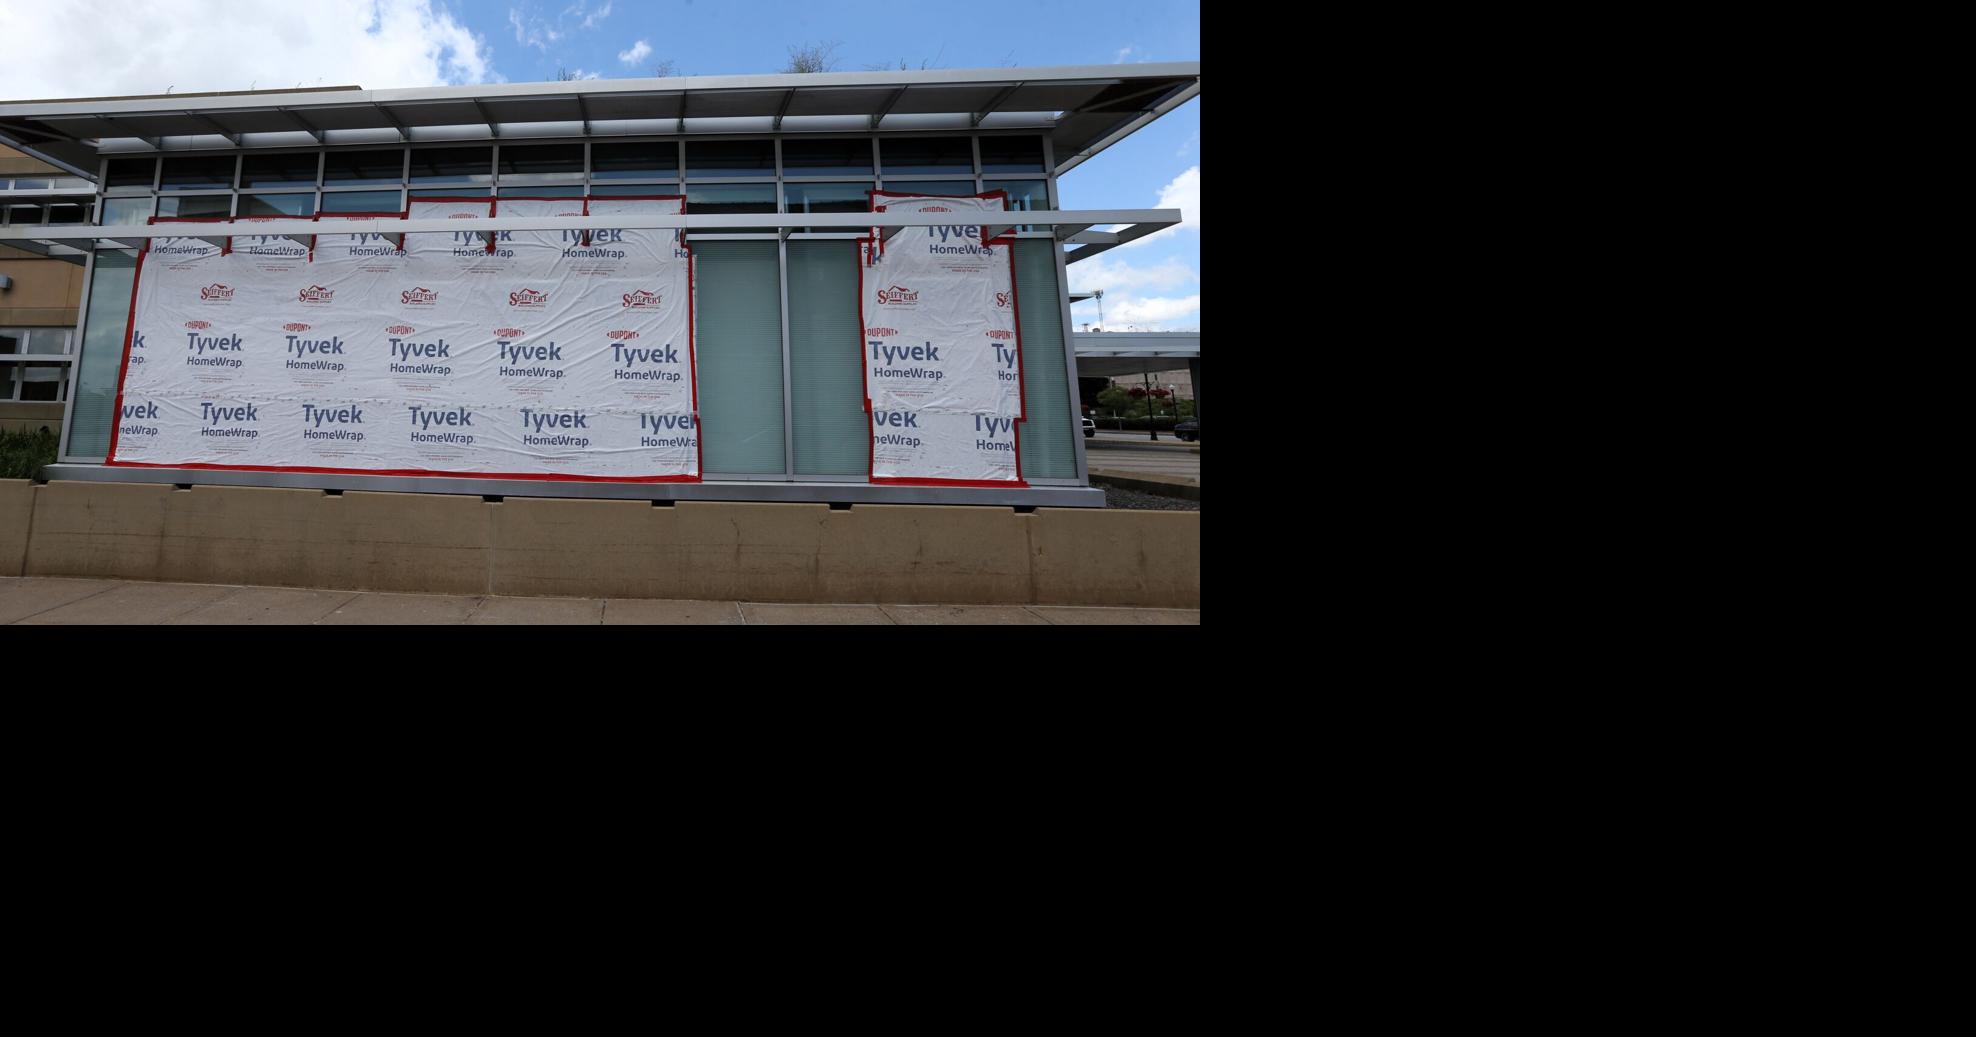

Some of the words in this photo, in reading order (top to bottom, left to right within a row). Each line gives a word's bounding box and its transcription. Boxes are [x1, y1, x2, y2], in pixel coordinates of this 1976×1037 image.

[154, 245, 208, 256] HomeWrap
[249, 246, 305, 257] HomeWrap
[562, 248, 625, 259] HomeWrap
[389, 326, 412, 335] DUPONT
[497, 328, 521, 337] DUPONT
[610, 331, 636, 340] DUPONT
[867, 328, 895, 337] DUPONT
[187, 332, 242, 355] Tyvek
[285, 335, 343, 358] Tyvek
[388, 338, 450, 361] Tyvek
[497, 341, 562, 365] Tyvek
[611, 343, 678, 368] Tyvek
[868, 341, 939, 365] Tyvek
[187, 356, 242, 368] HomeWrap
[286, 360, 344, 372] HomeWrap
[390, 363, 451, 376] HomeWrap
[500, 366, 563, 379] HomeWrap
[614, 369, 680, 382] HomeWrap
[874, 367, 943, 381] HomeWrap
[201, 402, 257, 425] Tyvek
[302, 404, 363, 428] Tyvek
[408, 406, 472, 430] Tyvek
[520, 408, 587, 433] Tyvek
[201, 427, 258, 439] HomeWrap
[303, 429, 364, 442] HomeWrap
[410, 432, 474, 445] HomeWrap
[523, 435, 589, 448] HomeWrap
